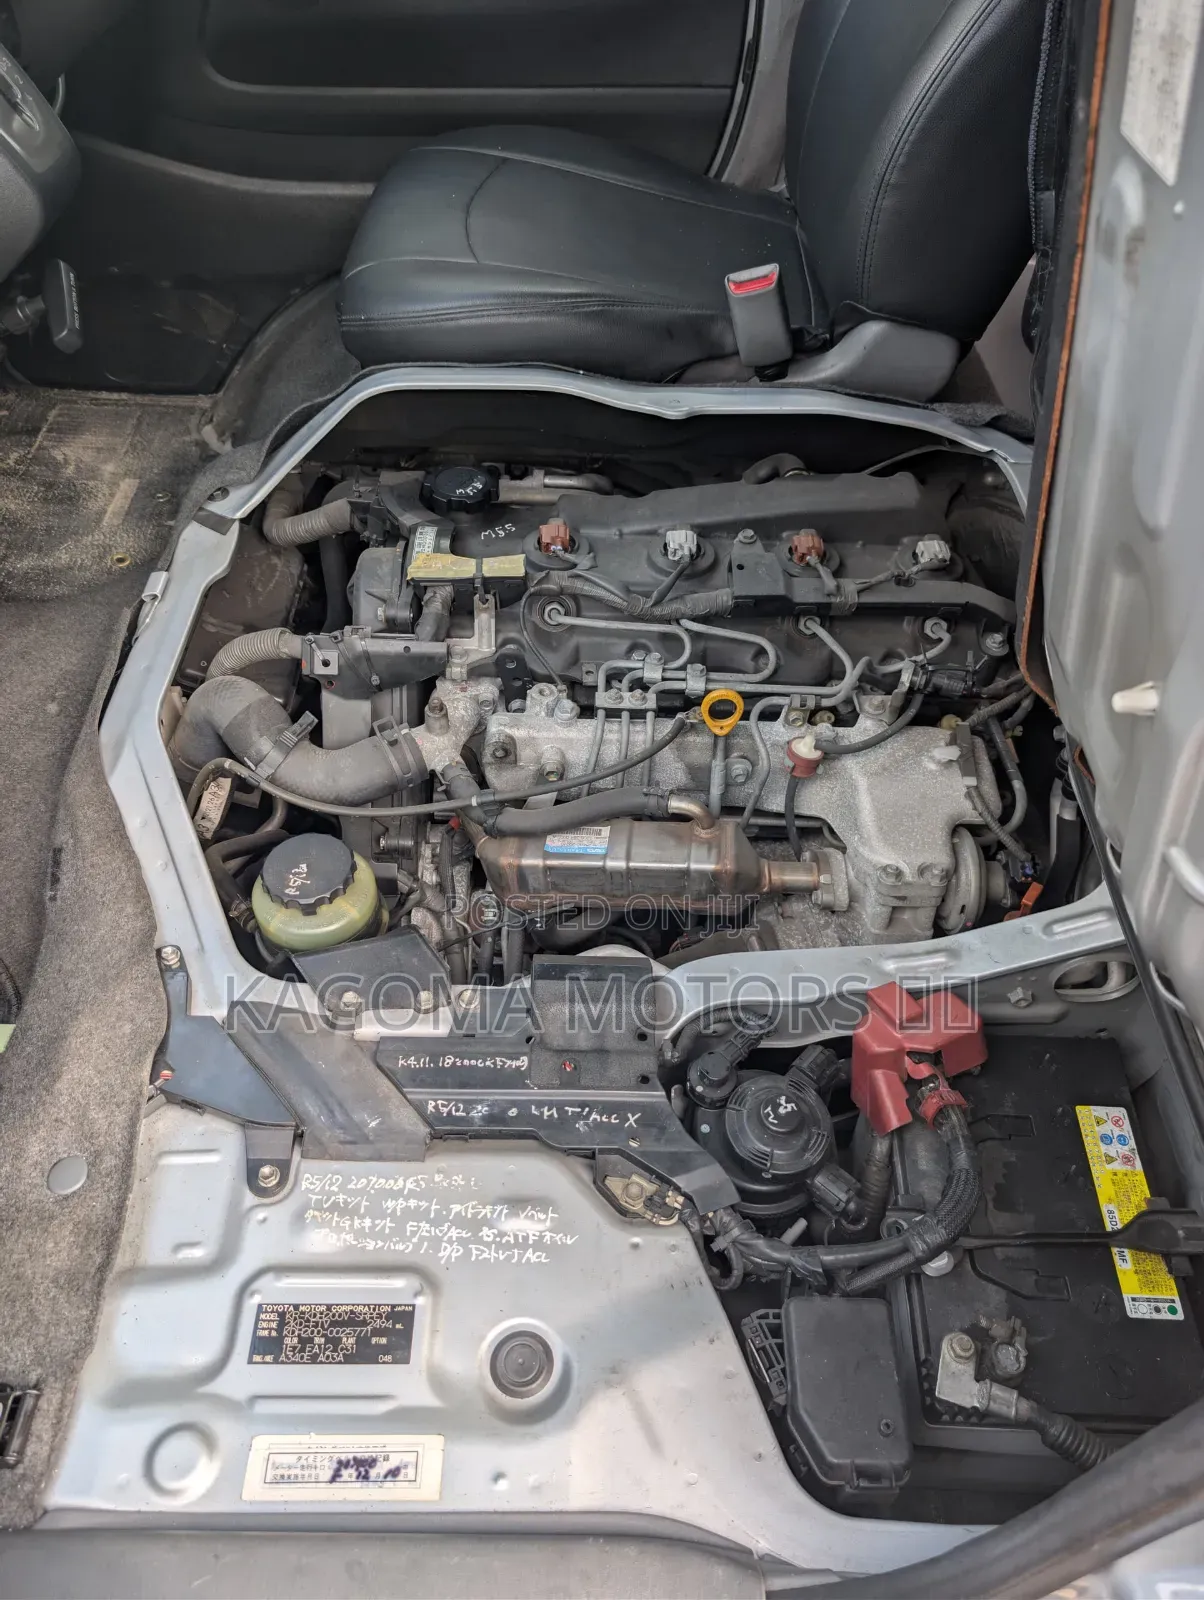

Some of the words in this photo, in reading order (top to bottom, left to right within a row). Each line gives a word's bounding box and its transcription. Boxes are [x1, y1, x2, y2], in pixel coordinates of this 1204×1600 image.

[262, 1304, 294, 1312] TOYOTA
[299, 1304, 327, 1312] MOTOR
[366, 1319, 393, 1329] 2494
[282, 1344, 301, 1355] 1E7
[337, 1344, 356, 1354] C31
[278, 1352, 312, 1363] A340E
[317, 1352, 345, 1363] A03A
[378, 1354, 393, 1363] 048
